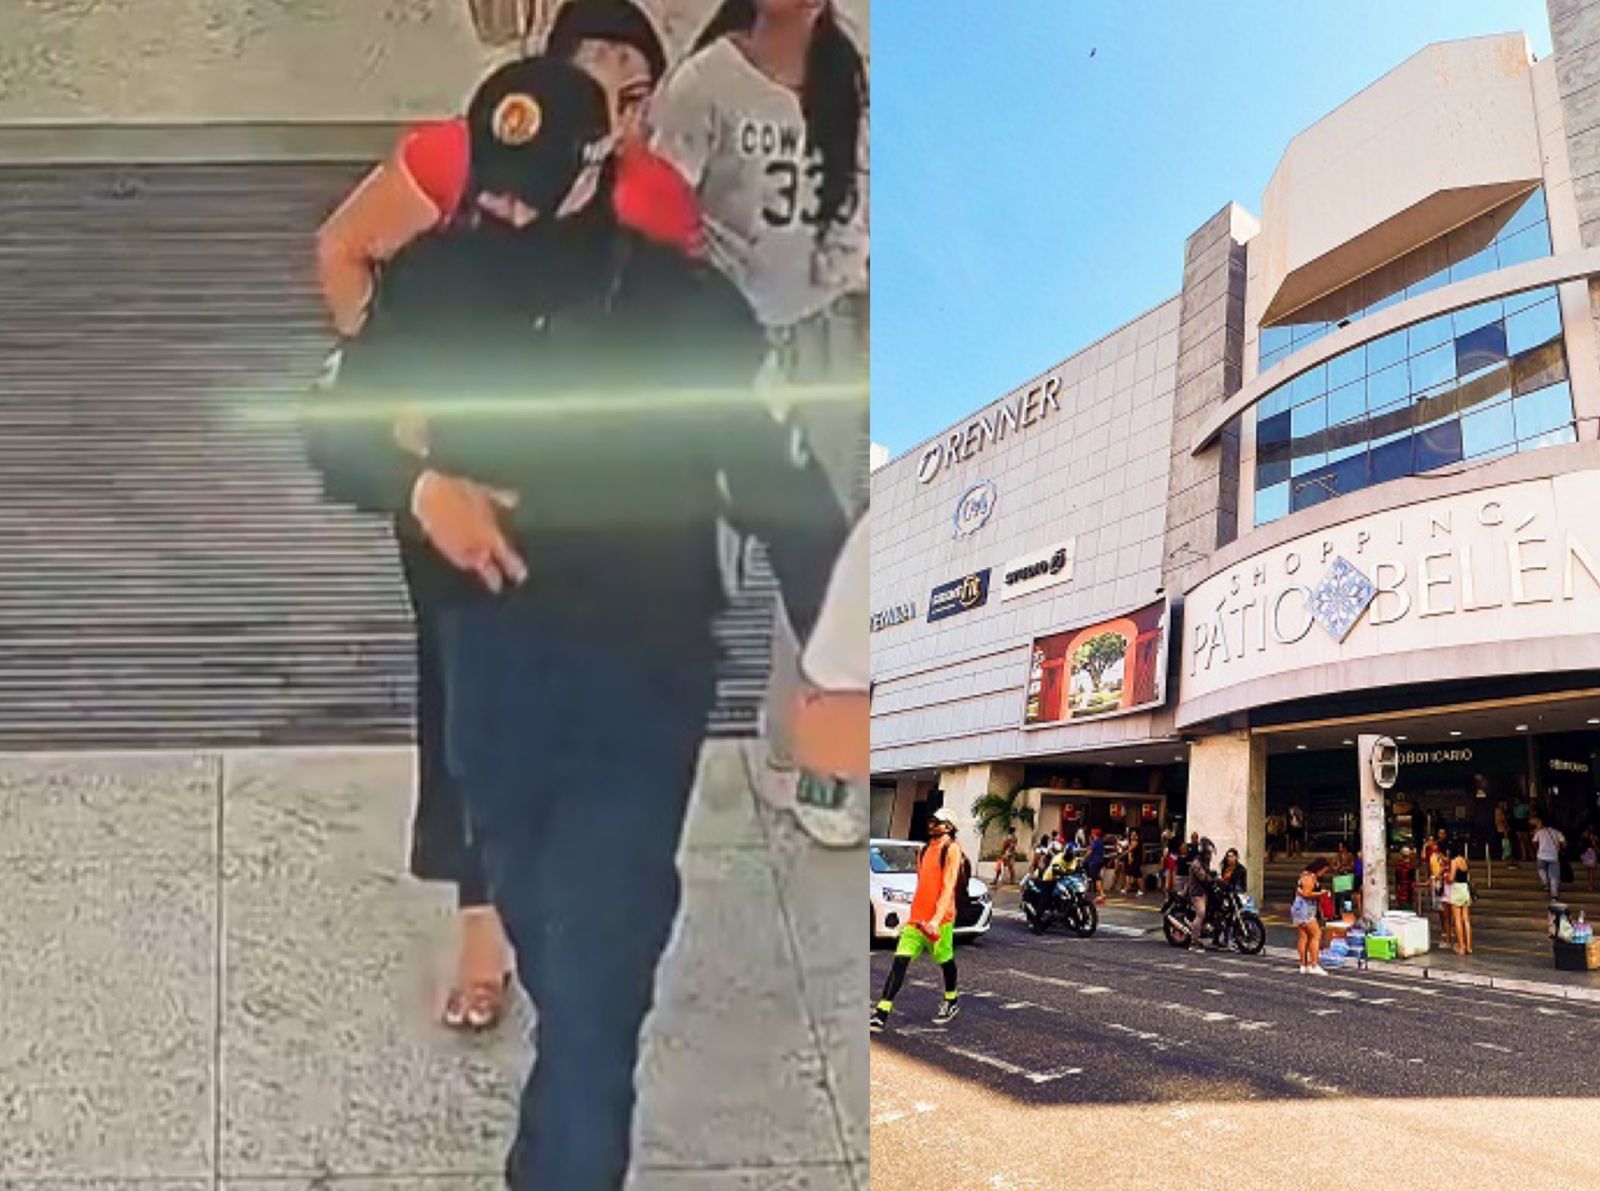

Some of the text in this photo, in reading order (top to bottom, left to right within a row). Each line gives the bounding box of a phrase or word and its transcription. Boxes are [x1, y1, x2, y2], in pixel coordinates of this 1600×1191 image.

[740, 121, 812, 158] COW
[944, 376, 1062, 469] RENNER
[1231, 501, 1504, 597] SHOPPING
[1190, 584, 1317, 677] PÁTIO
